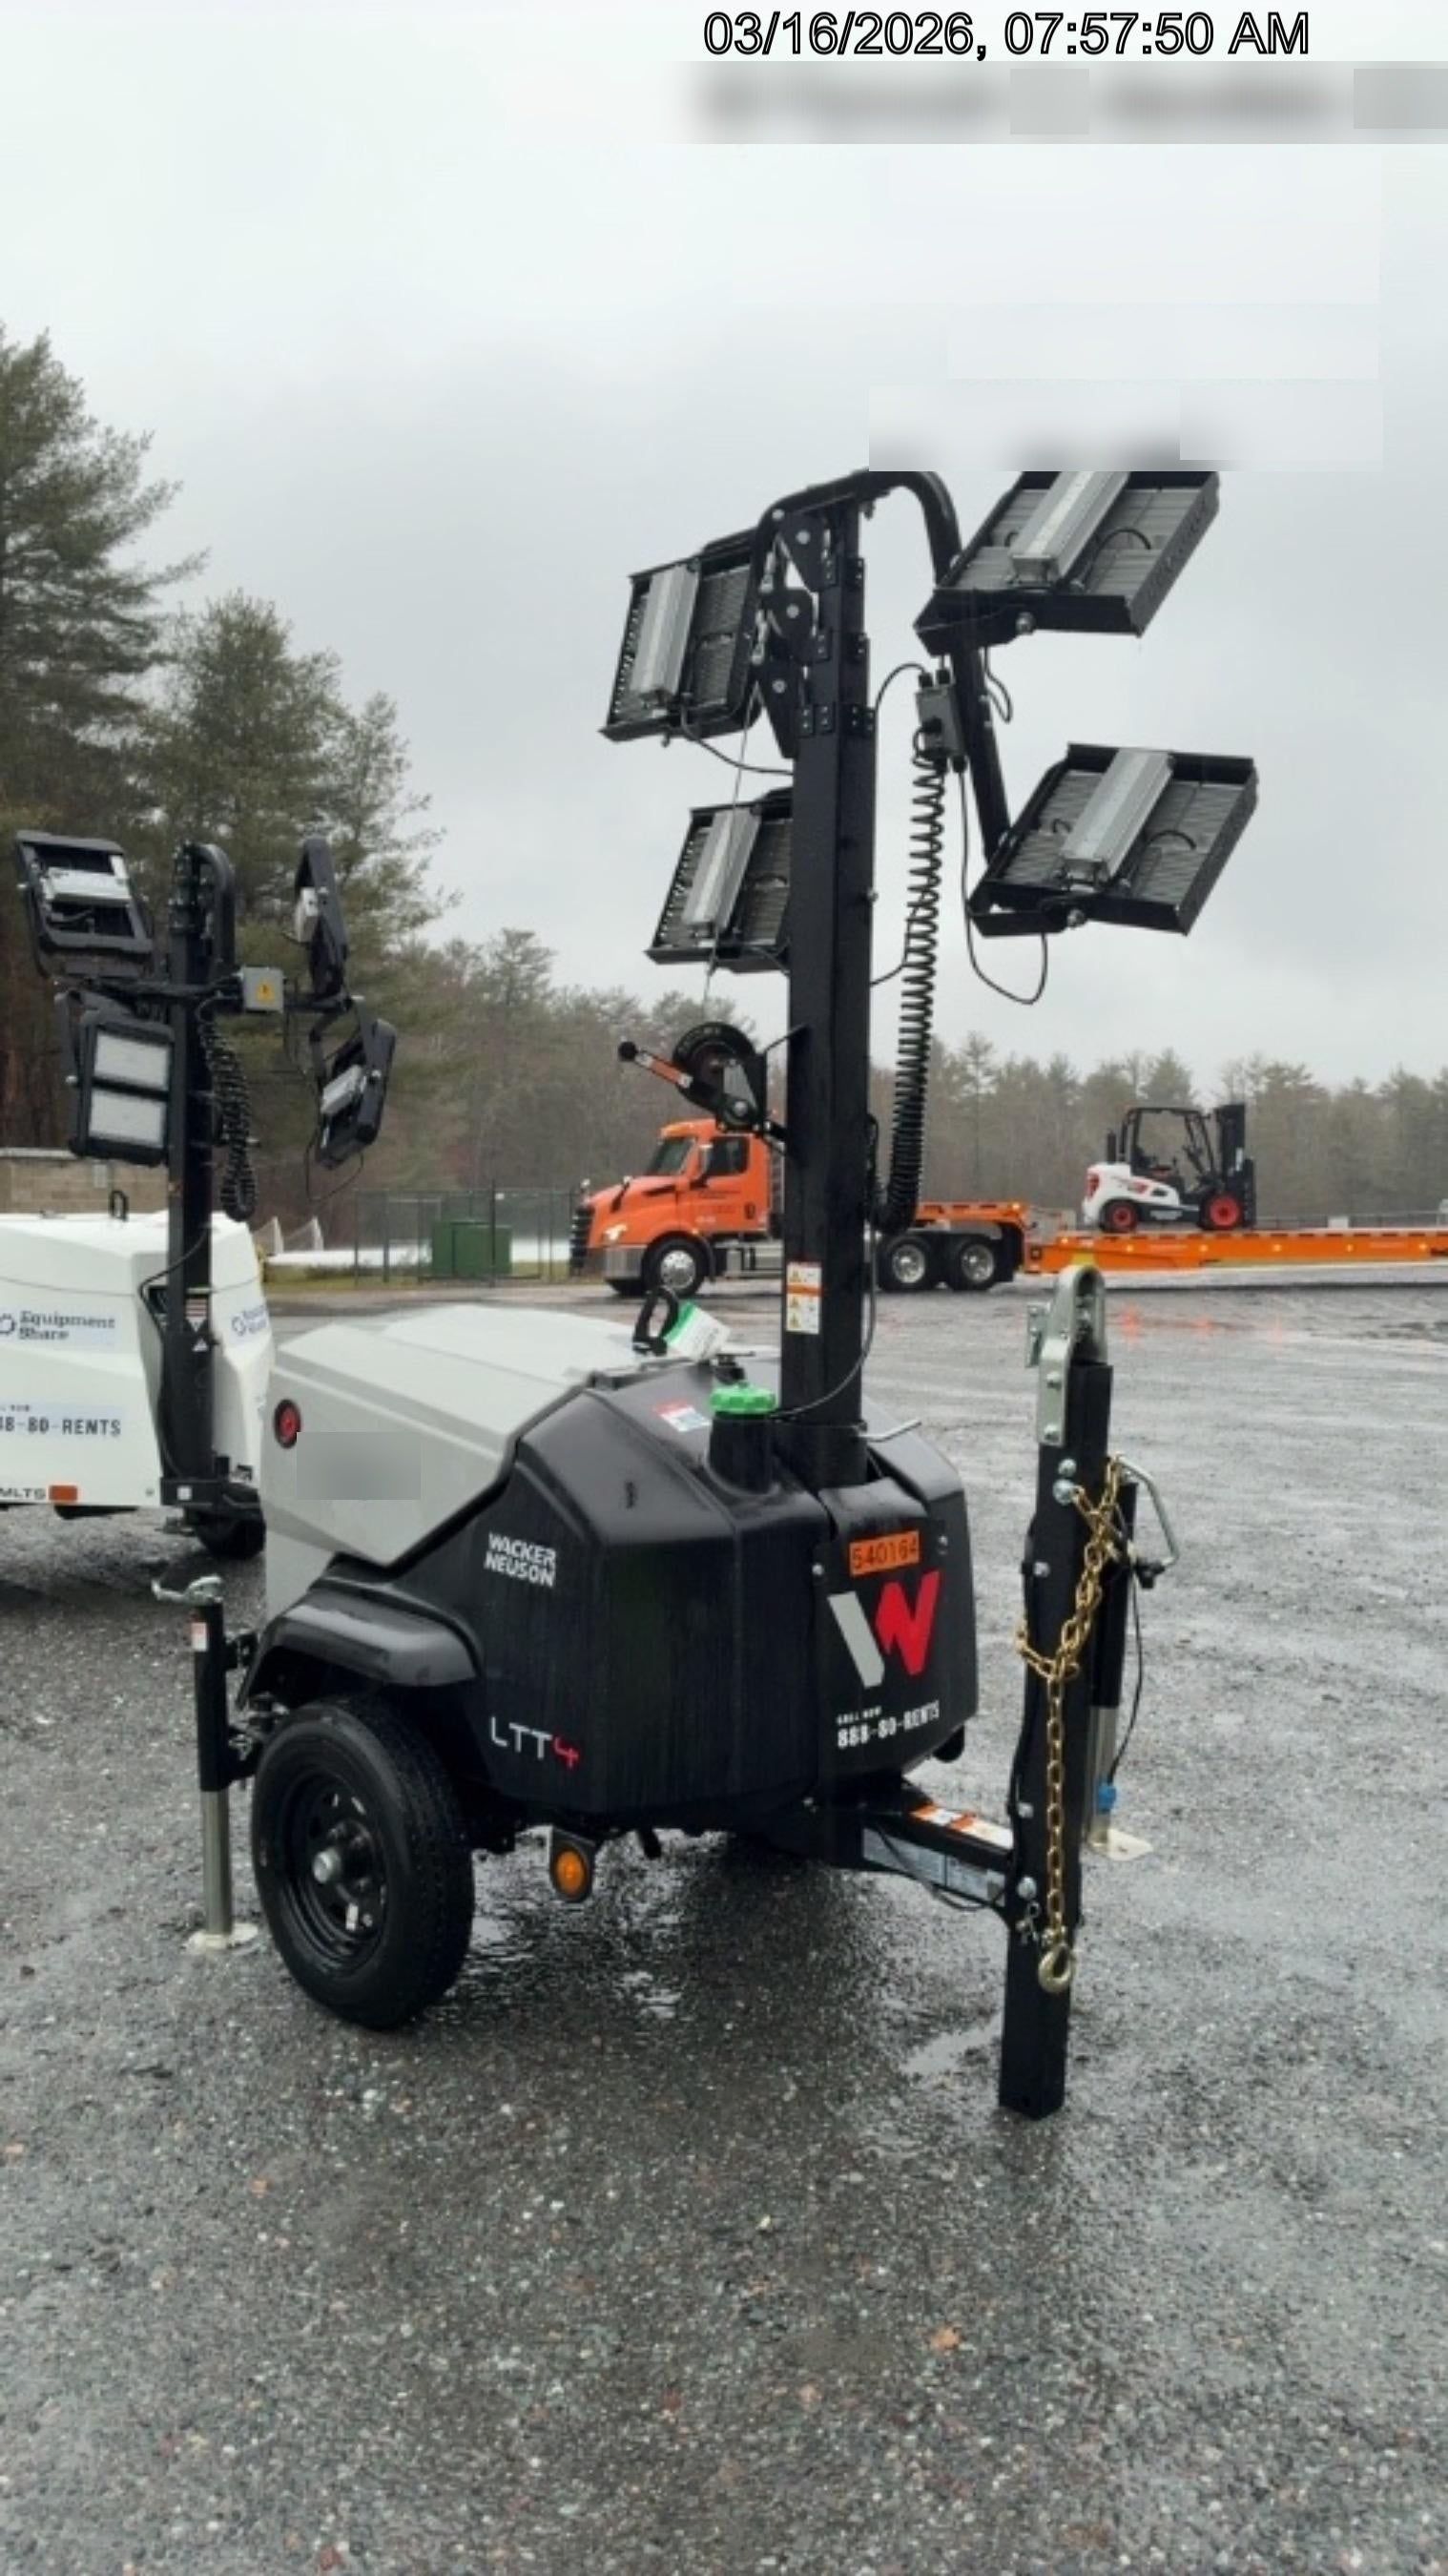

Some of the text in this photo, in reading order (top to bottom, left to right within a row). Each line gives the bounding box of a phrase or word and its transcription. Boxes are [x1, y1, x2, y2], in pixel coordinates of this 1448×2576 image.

[19, 1310, 115, 1328] Equipment
[488, 1531, 556, 1566] WACKER
[484, 1550, 555, 1588] NEUSON
